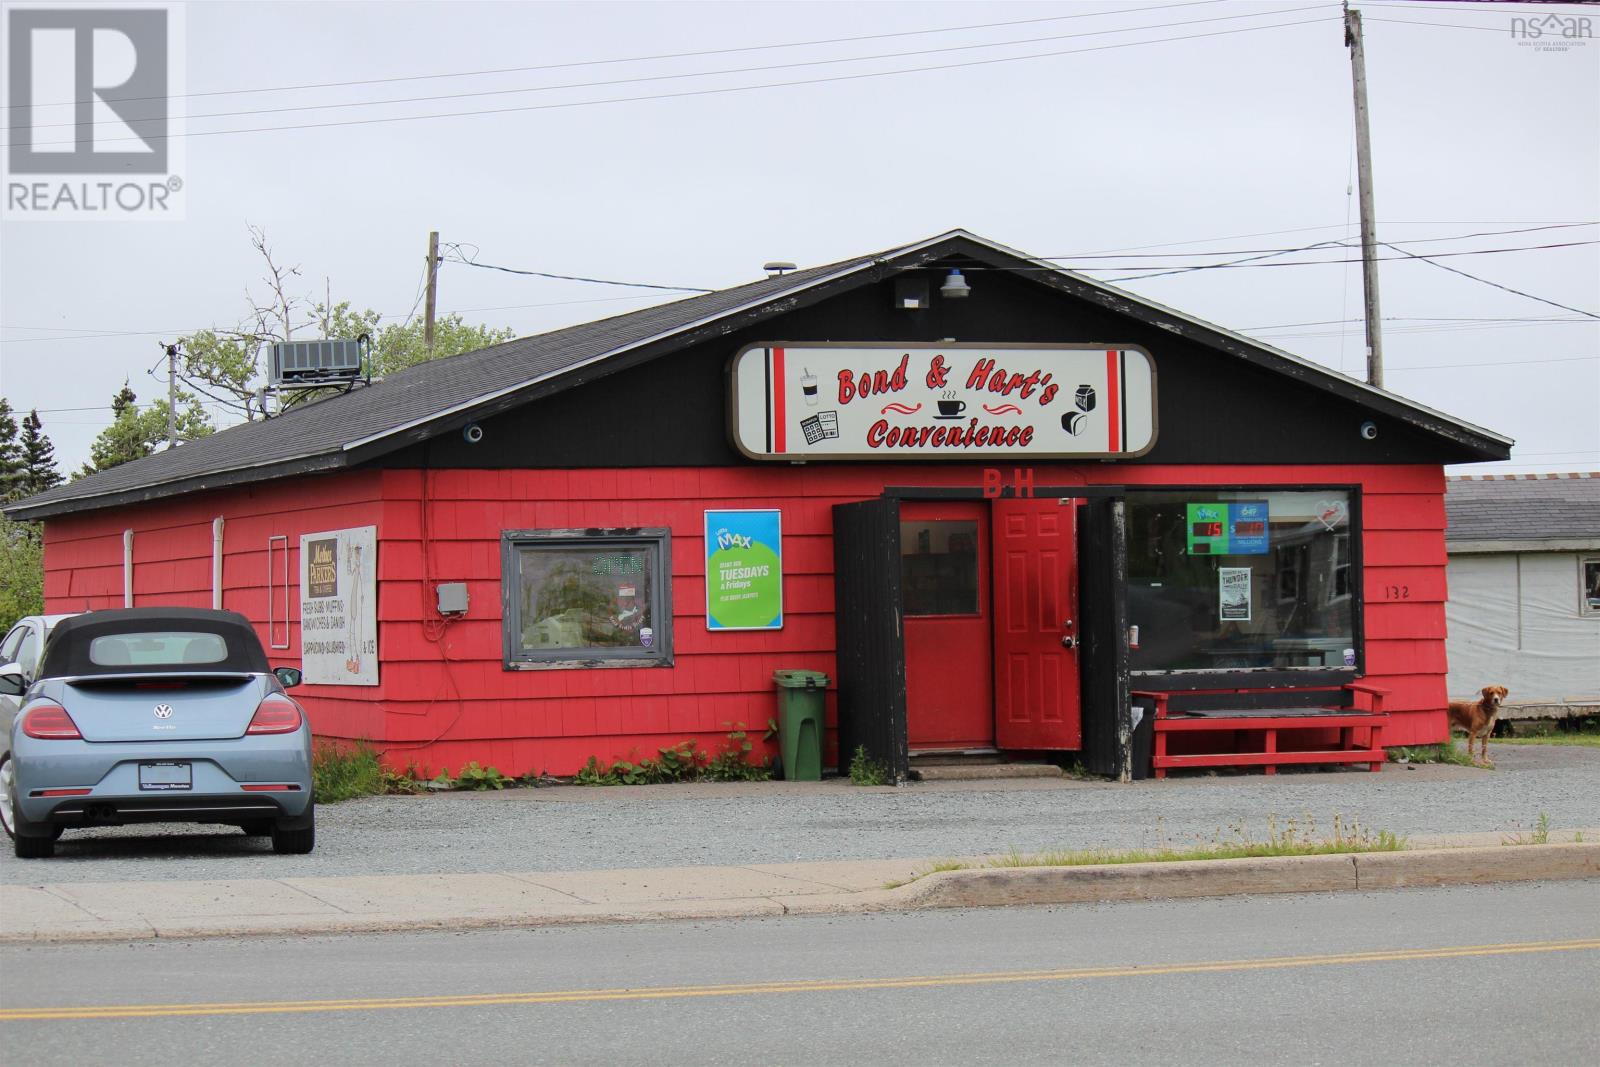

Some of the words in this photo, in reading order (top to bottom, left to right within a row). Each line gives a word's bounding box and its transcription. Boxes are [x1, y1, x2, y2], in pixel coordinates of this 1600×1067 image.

[838, 354, 909, 405] Bond
[926, 355, 952, 389] &
[966, 358, 1059, 406] Hart's
[867, 417, 1034, 449] Convenience
[718, 533, 751, 550] MAX
[592, 555, 642, 575] OPEN
[720, 565, 769, 581] TUESDAYS
[726, 580, 752, 590] Fridays
[1222, 573, 1249, 584] THUNDER
[1385, 585, 1409, 600] 132
